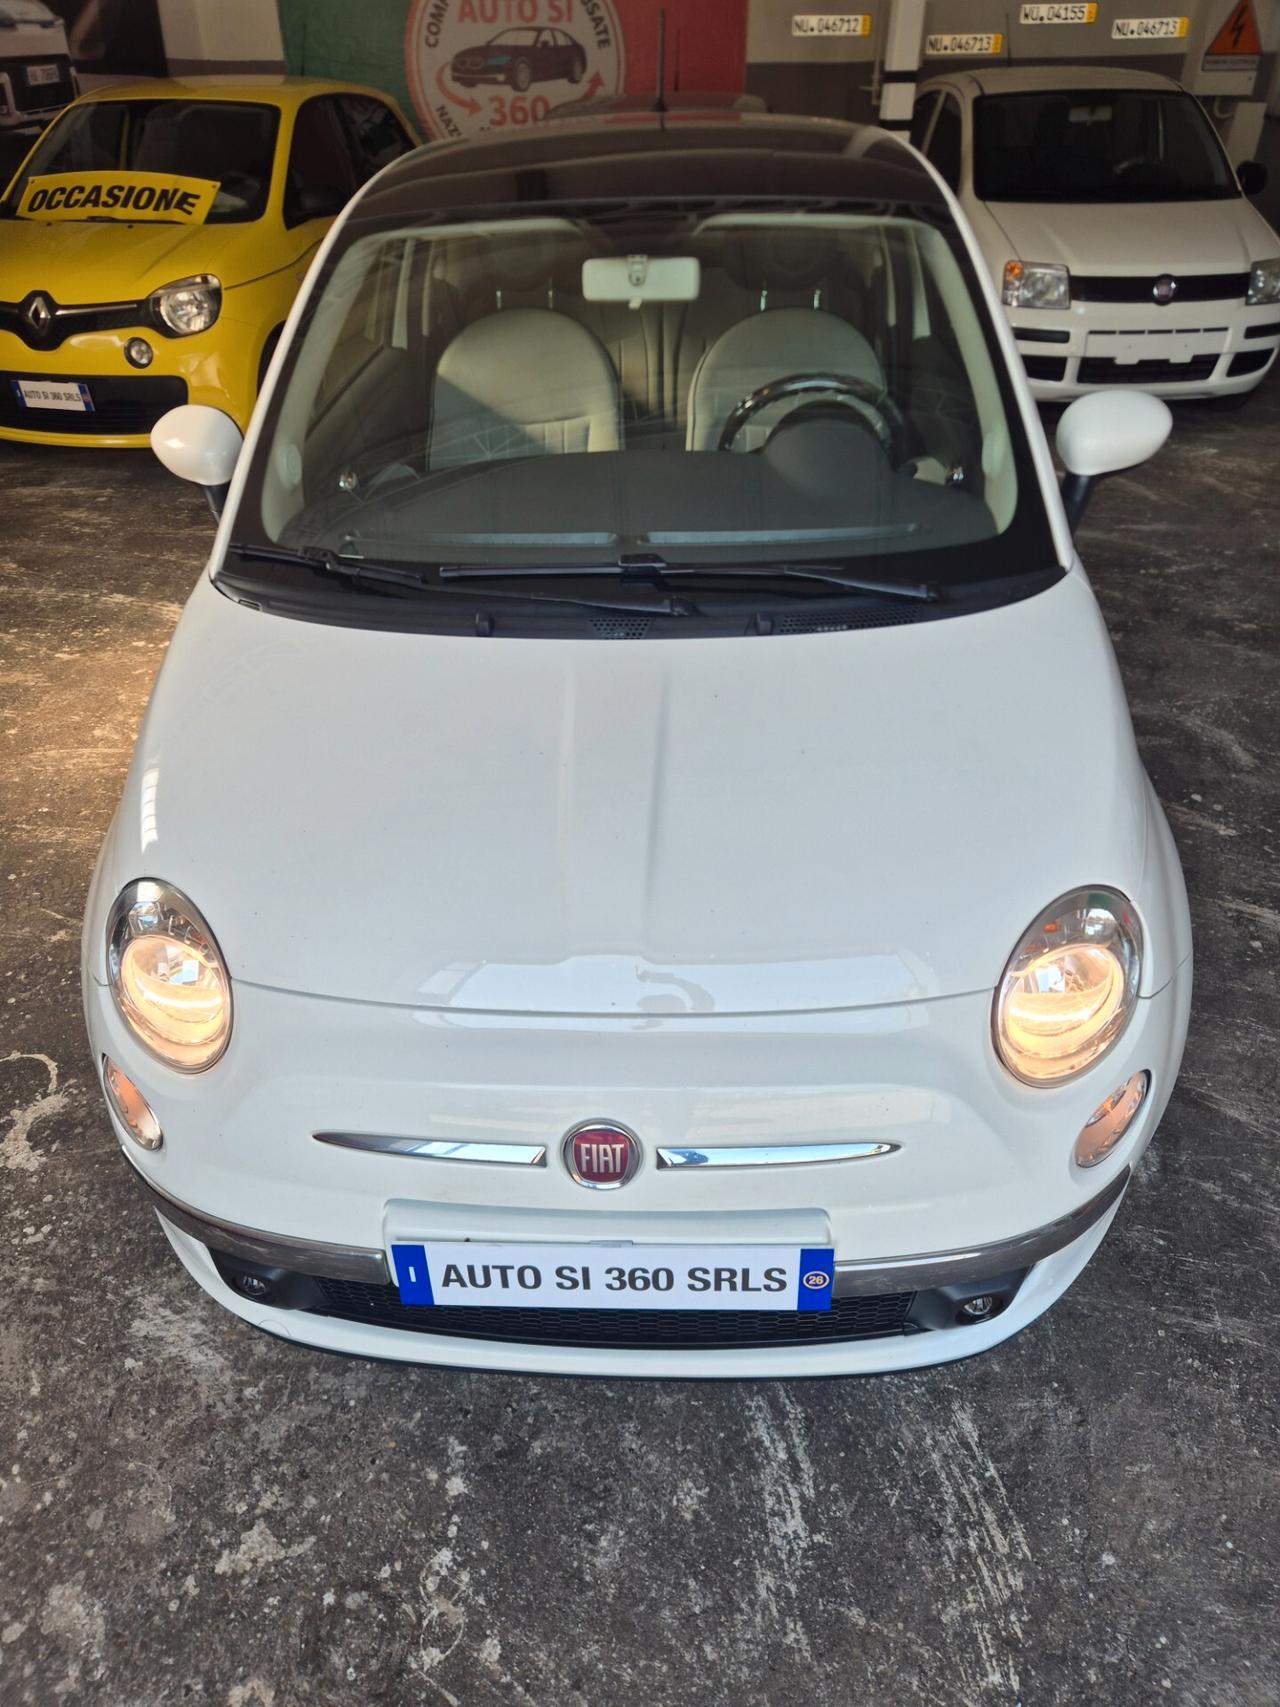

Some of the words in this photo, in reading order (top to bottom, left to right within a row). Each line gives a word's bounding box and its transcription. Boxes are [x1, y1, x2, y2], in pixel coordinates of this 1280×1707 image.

[457, 0, 538, 24] AUTO
[548, 0, 574, 23] SI
[489, 95, 550, 126] 360
[28, 184, 201, 215] OCCASIONE
[580, 1143, 625, 1173] FIAT
[441, 1263, 542, 1289] AUTO
[555, 1265, 591, 1290] SI
[605, 1266, 674, 1291] 360
[687, 1266, 788, 1292] SRLS
[808, 1275, 825, 1286] 26
